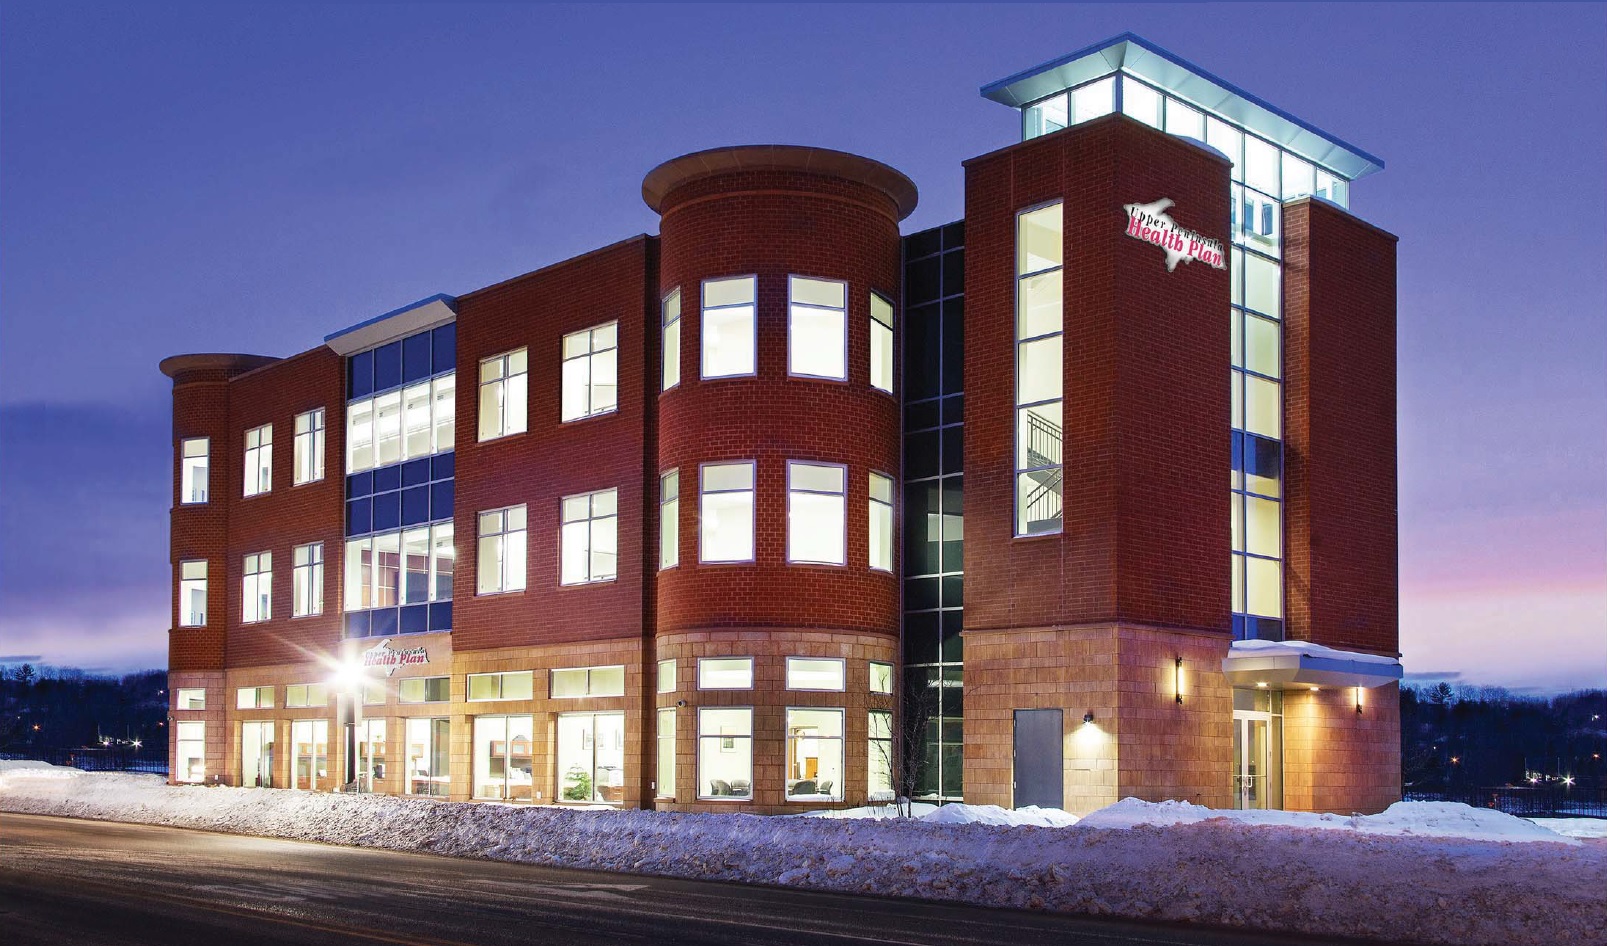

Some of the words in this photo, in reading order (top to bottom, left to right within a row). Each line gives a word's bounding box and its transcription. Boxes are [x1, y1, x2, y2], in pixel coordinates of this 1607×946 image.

[1128, 216, 1184, 252] Health
[1187, 240, 1221, 266] Plan
[1130, 207, 1166, 228] Upper
[1171, 223, 1223, 251] Peninsula
[399, 652, 424, 664] Plan
